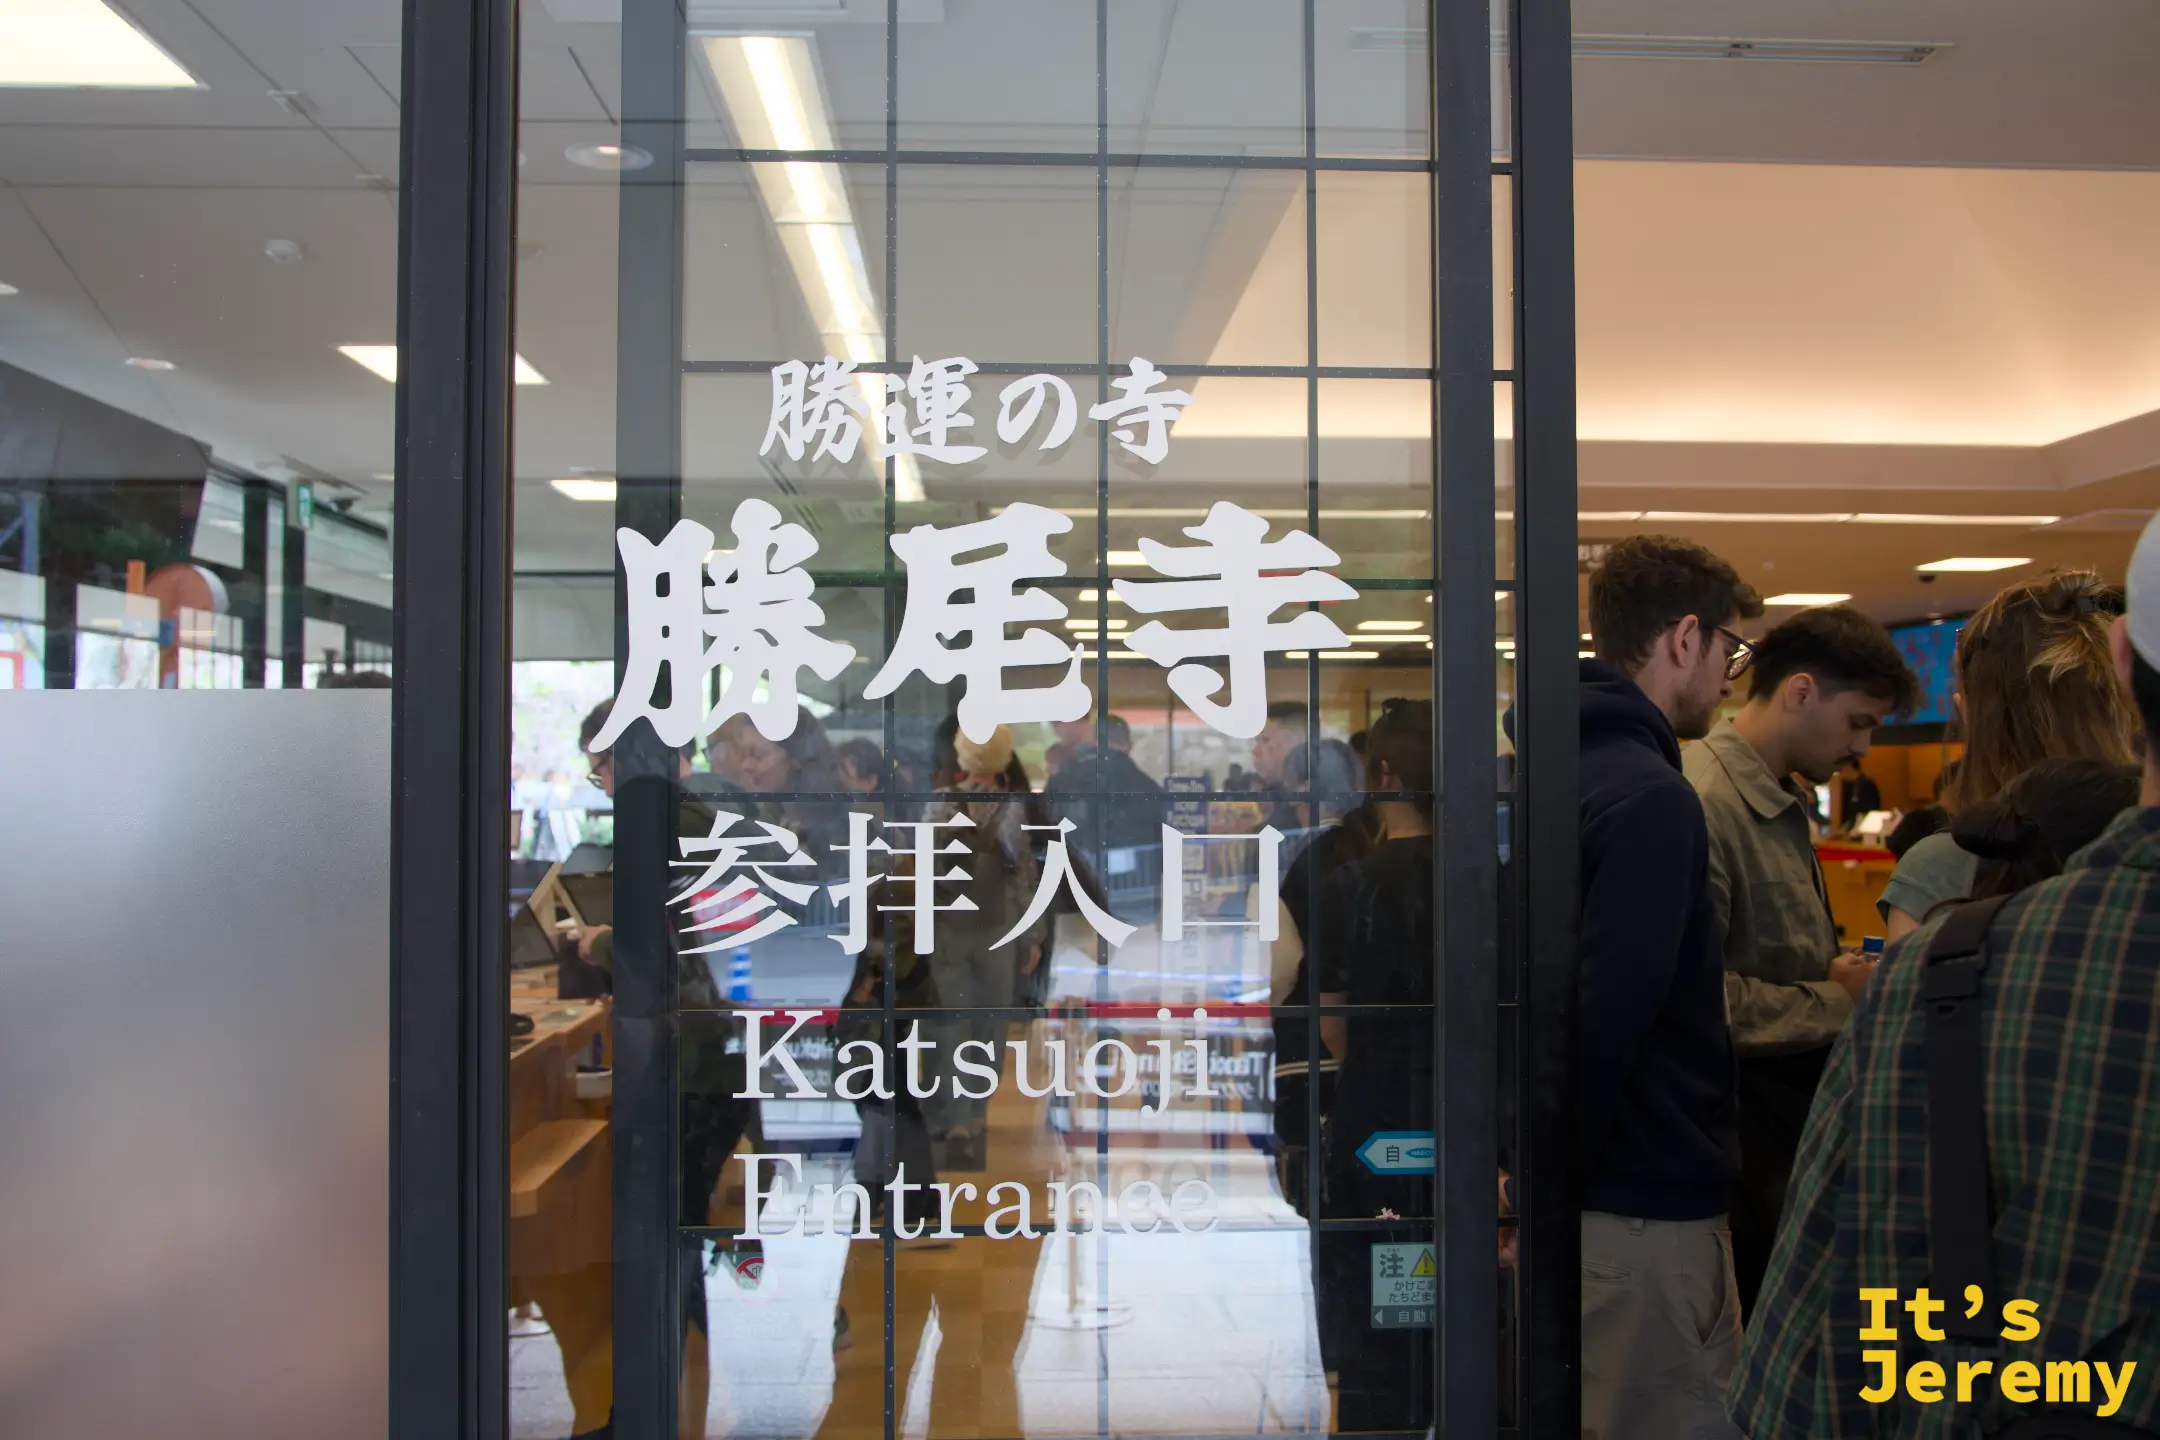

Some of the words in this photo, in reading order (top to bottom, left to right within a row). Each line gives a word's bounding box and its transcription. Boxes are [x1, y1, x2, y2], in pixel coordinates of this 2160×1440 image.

[759, 355, 1193, 464] 勝運の寺
[588, 498, 1360, 753] 勝尾寺
[665, 810, 1285, 955] 参拝入口
[732, 1008, 1219, 1118] Katsuoji
[733, 1153, 1219, 1239] Entrance
[1380, 1253, 1404, 1278] 注
[1389, 1292, 1435, 1302] たちどま
